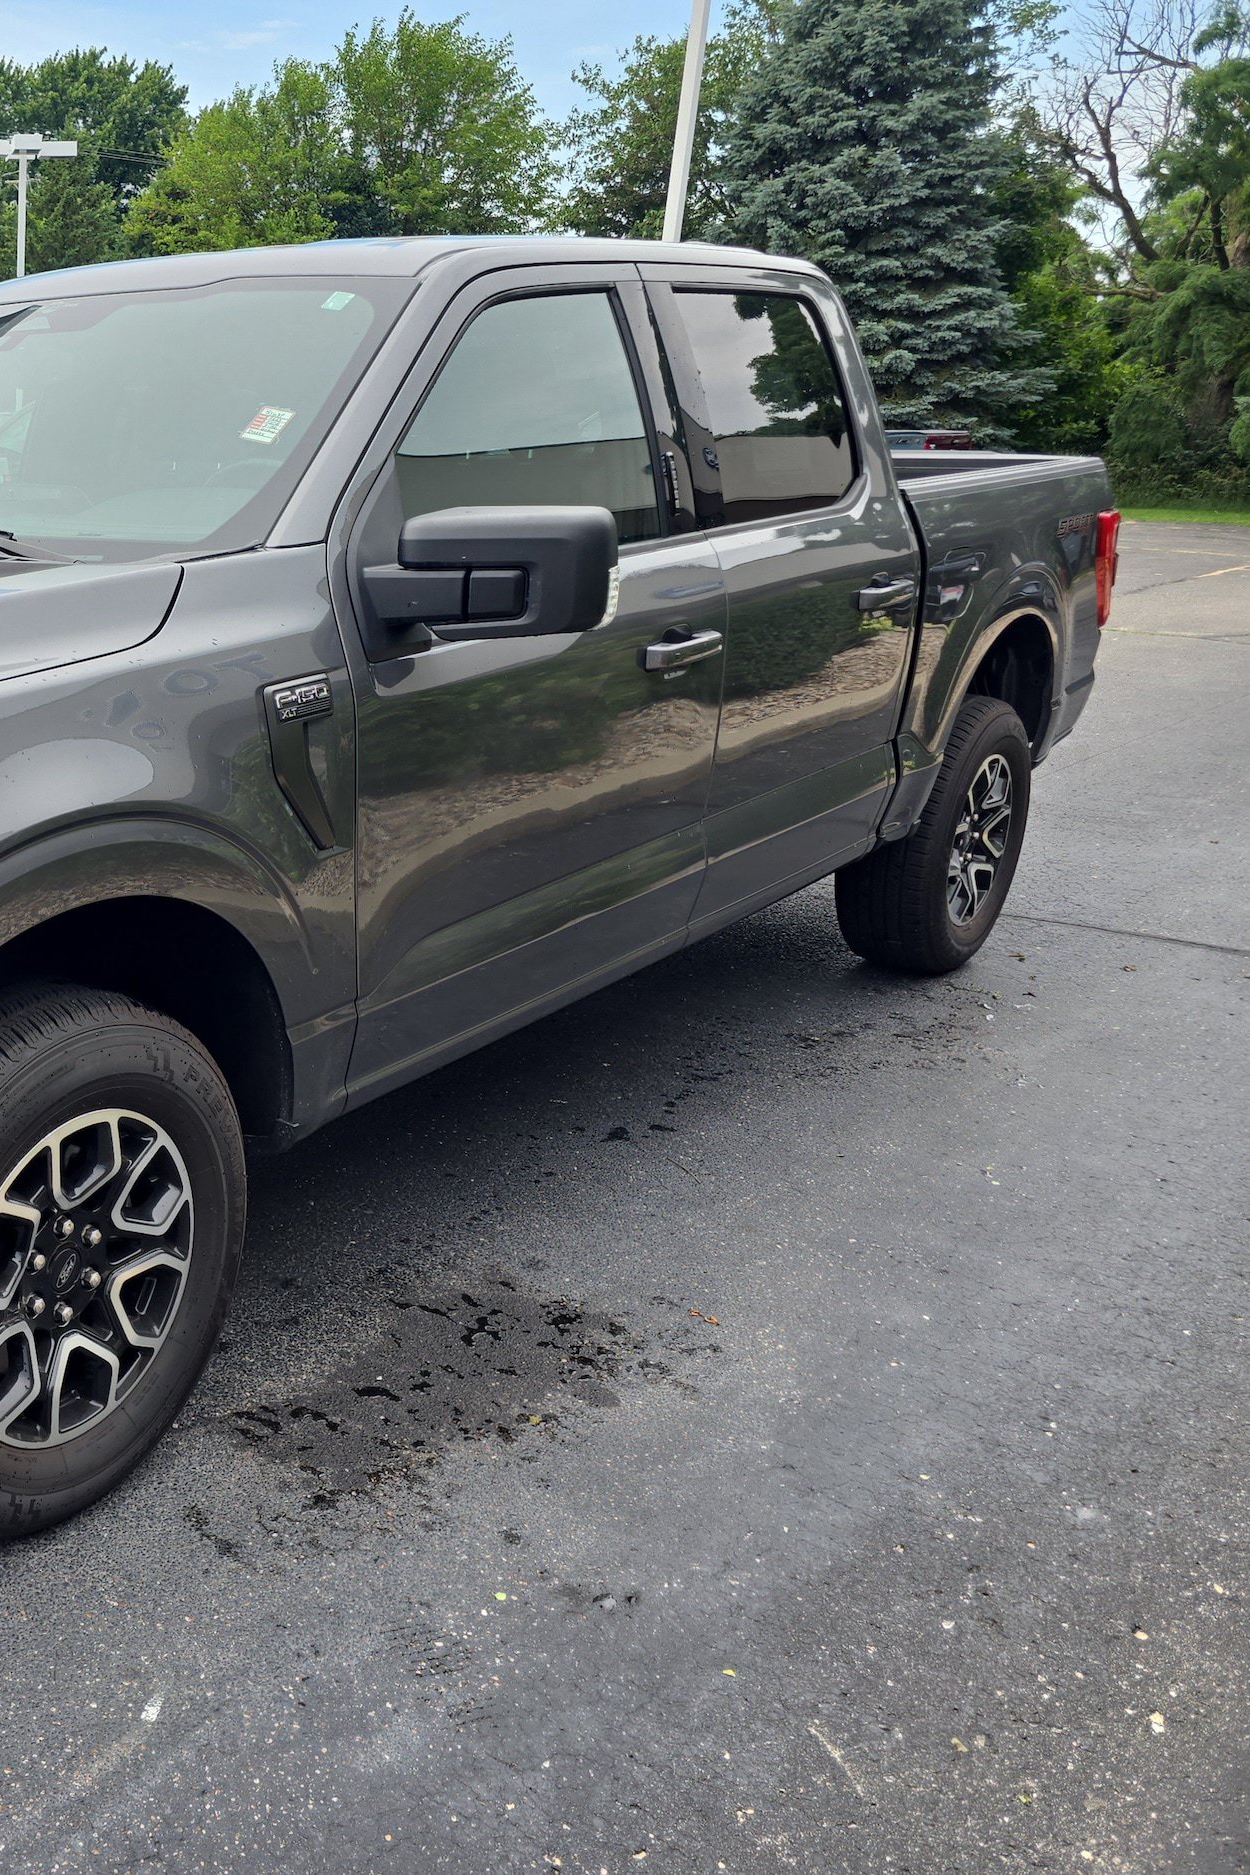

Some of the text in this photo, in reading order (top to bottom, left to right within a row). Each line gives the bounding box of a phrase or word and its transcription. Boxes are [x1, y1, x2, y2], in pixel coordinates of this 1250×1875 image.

[1056, 512, 1095, 538] SPORT
[275, 682, 331, 710] F-150
[281, 707, 298, 720] XLT
